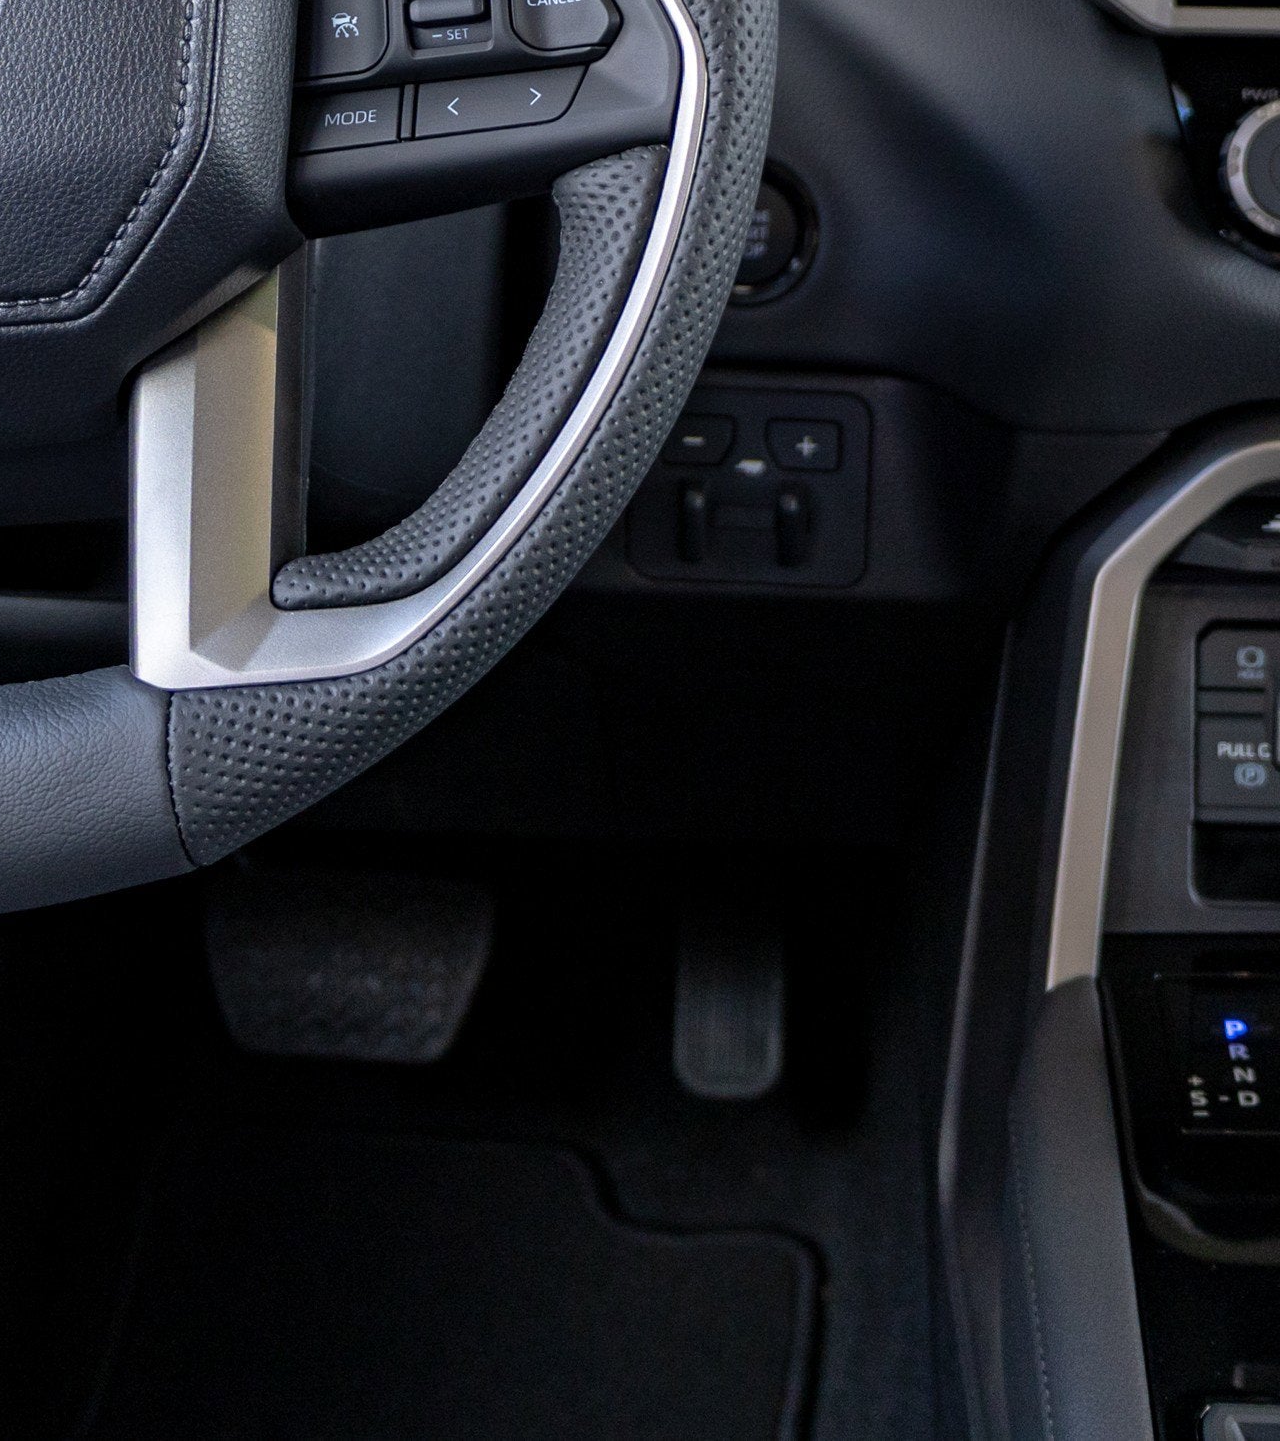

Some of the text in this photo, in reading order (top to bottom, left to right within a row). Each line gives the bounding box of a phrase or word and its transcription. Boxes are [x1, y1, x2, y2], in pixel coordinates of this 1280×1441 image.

[324, 109, 377, 127] MODE
[1217, 741, 1255, 759] PULL
[1224, 1019, 1248, 1040] P
[1228, 1043, 1250, 1059] R
[1232, 1067, 1256, 1083] N
[1189, 1090, 1260, 1107] S D
